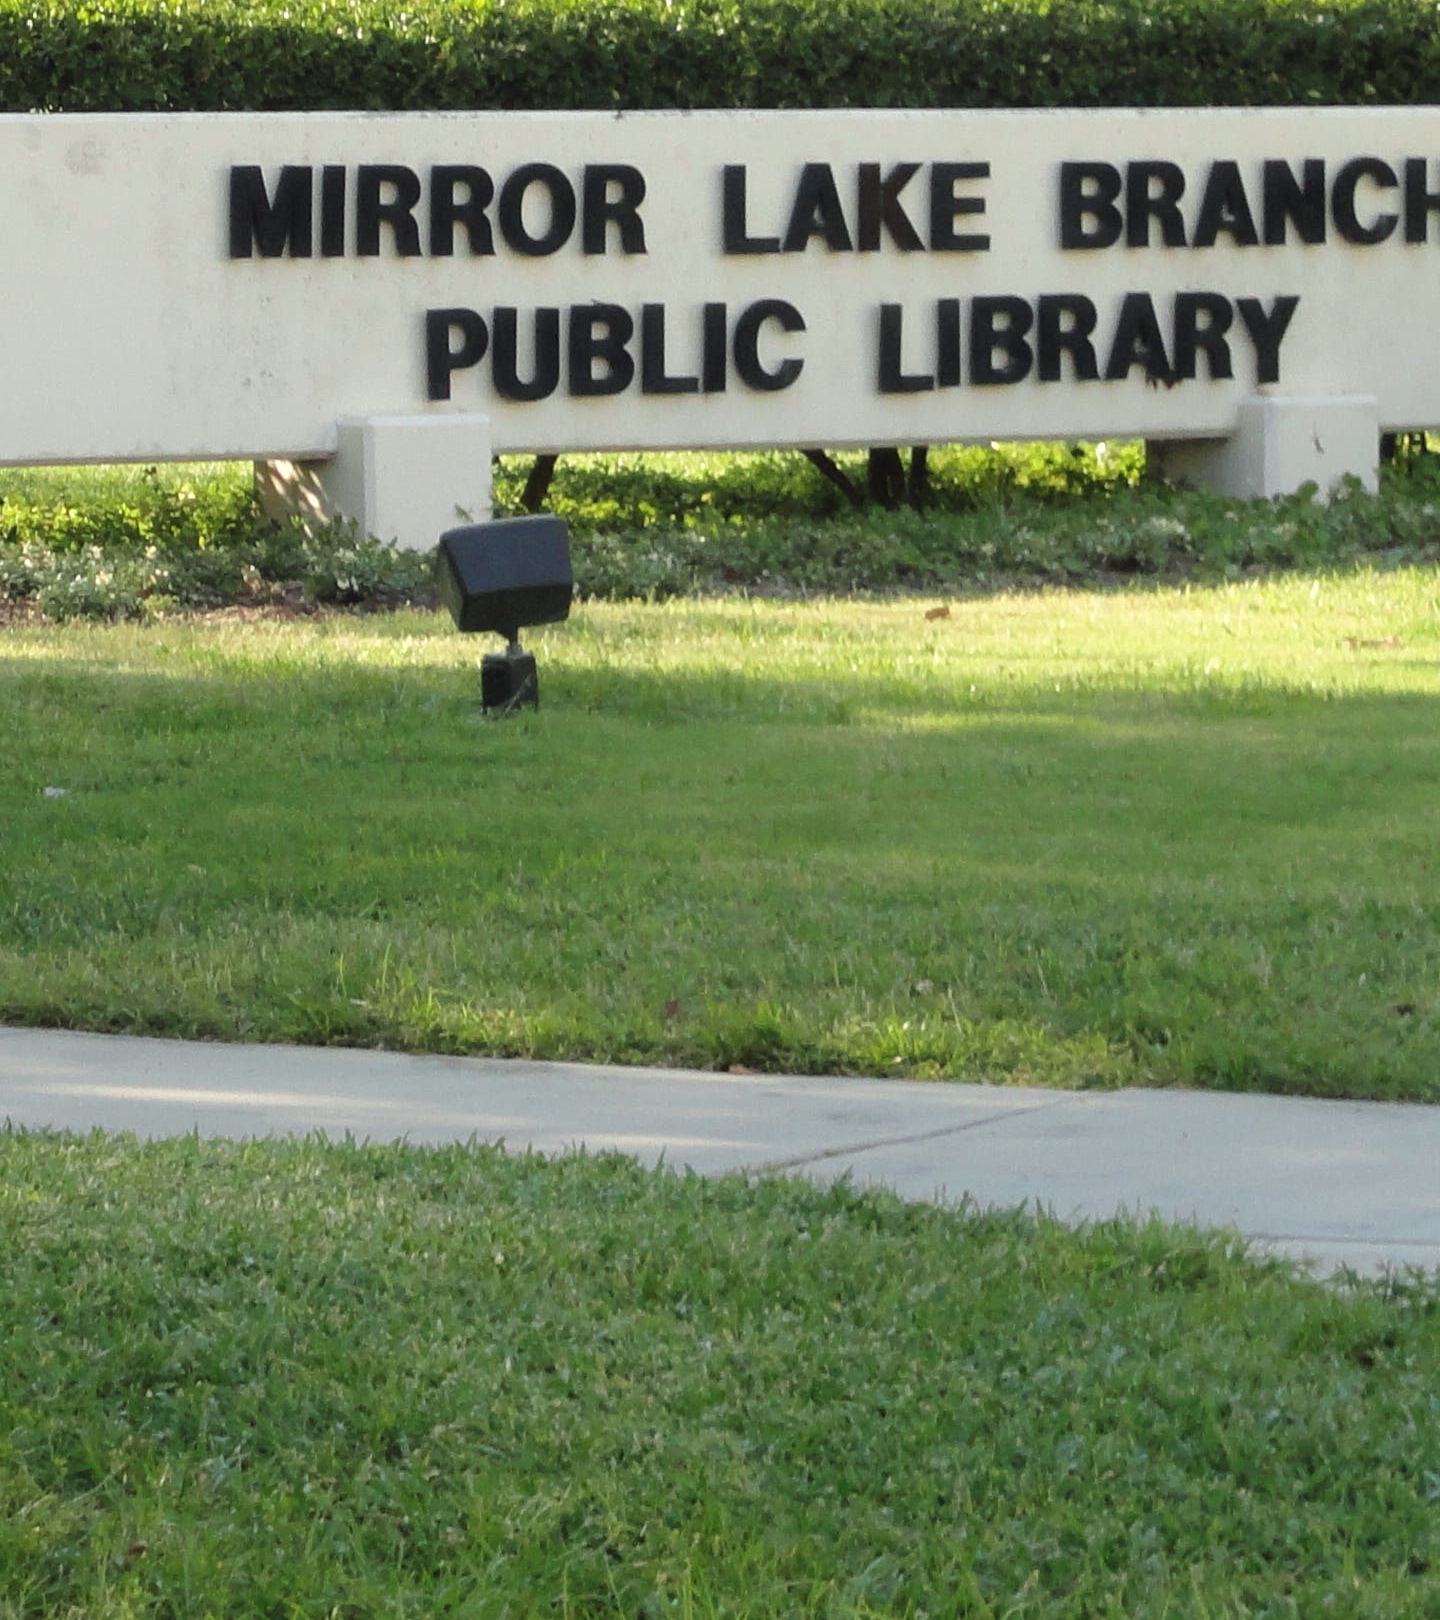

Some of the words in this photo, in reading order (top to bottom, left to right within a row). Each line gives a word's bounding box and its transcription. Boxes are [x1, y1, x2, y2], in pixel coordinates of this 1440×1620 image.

[227, 163, 647, 259] MIRROR
[722, 162, 991, 256] LAKE
[424, 298, 806, 403] PUBLIC
[877, 291, 1300, 391] LIBRARY
